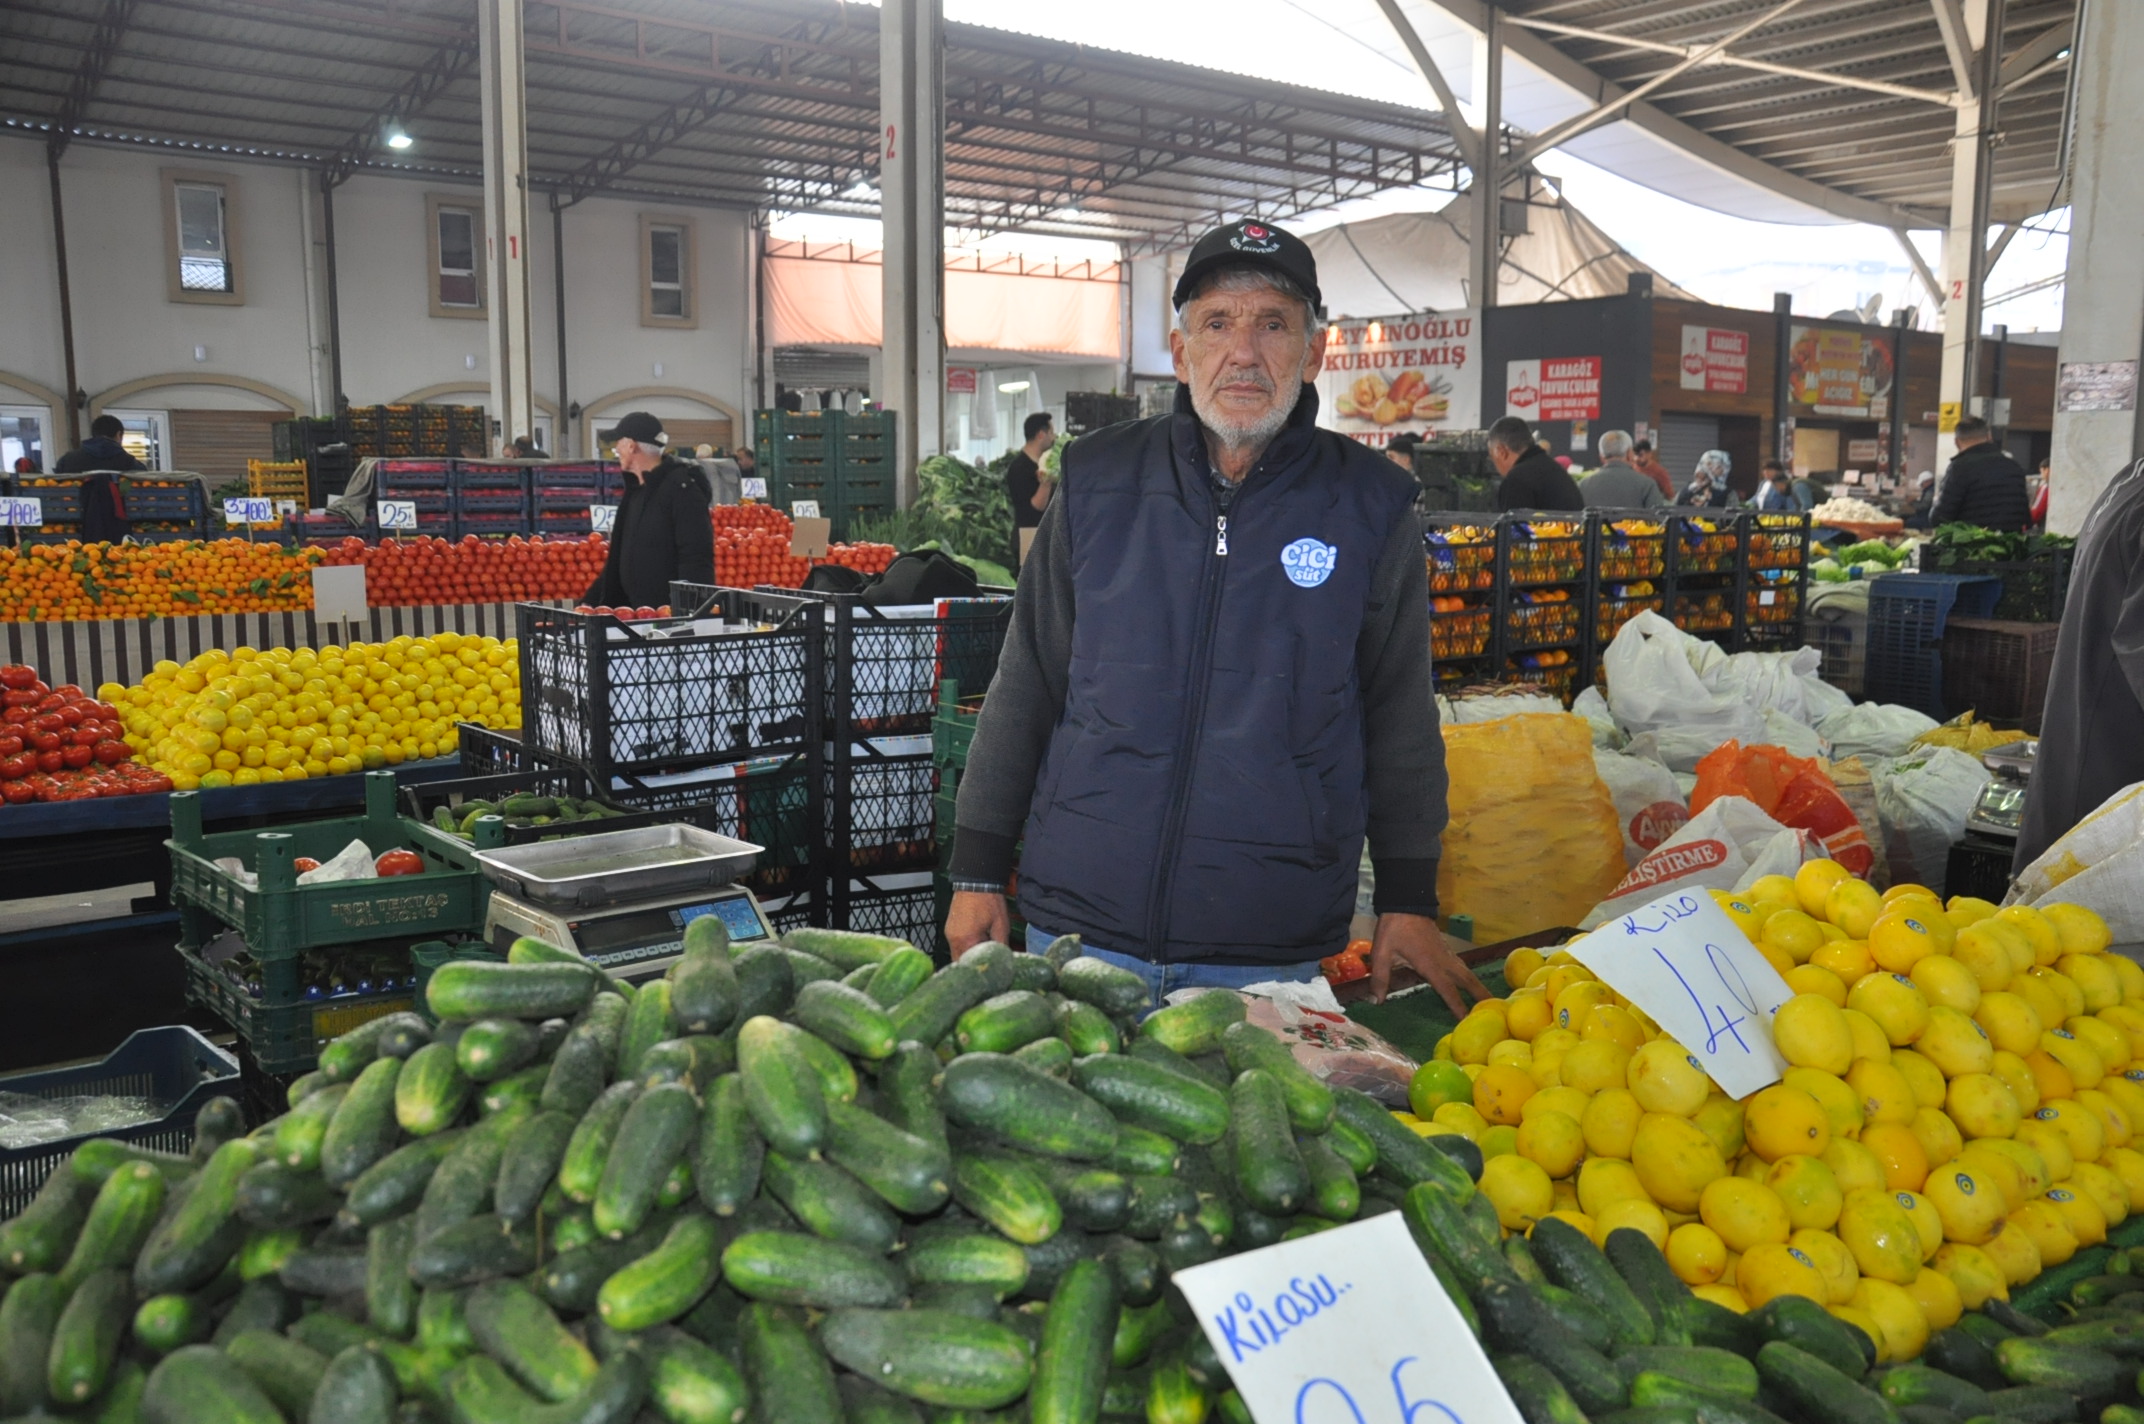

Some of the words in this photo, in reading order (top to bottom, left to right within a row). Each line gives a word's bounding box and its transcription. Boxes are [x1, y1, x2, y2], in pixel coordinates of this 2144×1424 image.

[886, 125, 895, 160] 2
[509, 236, 517, 259] 1
[1952, 280, 1962, 300] 2
[1325, 341, 1466, 369] KURUYEMİŞ
[1547, 360, 1593, 378] KARAGÖZ
